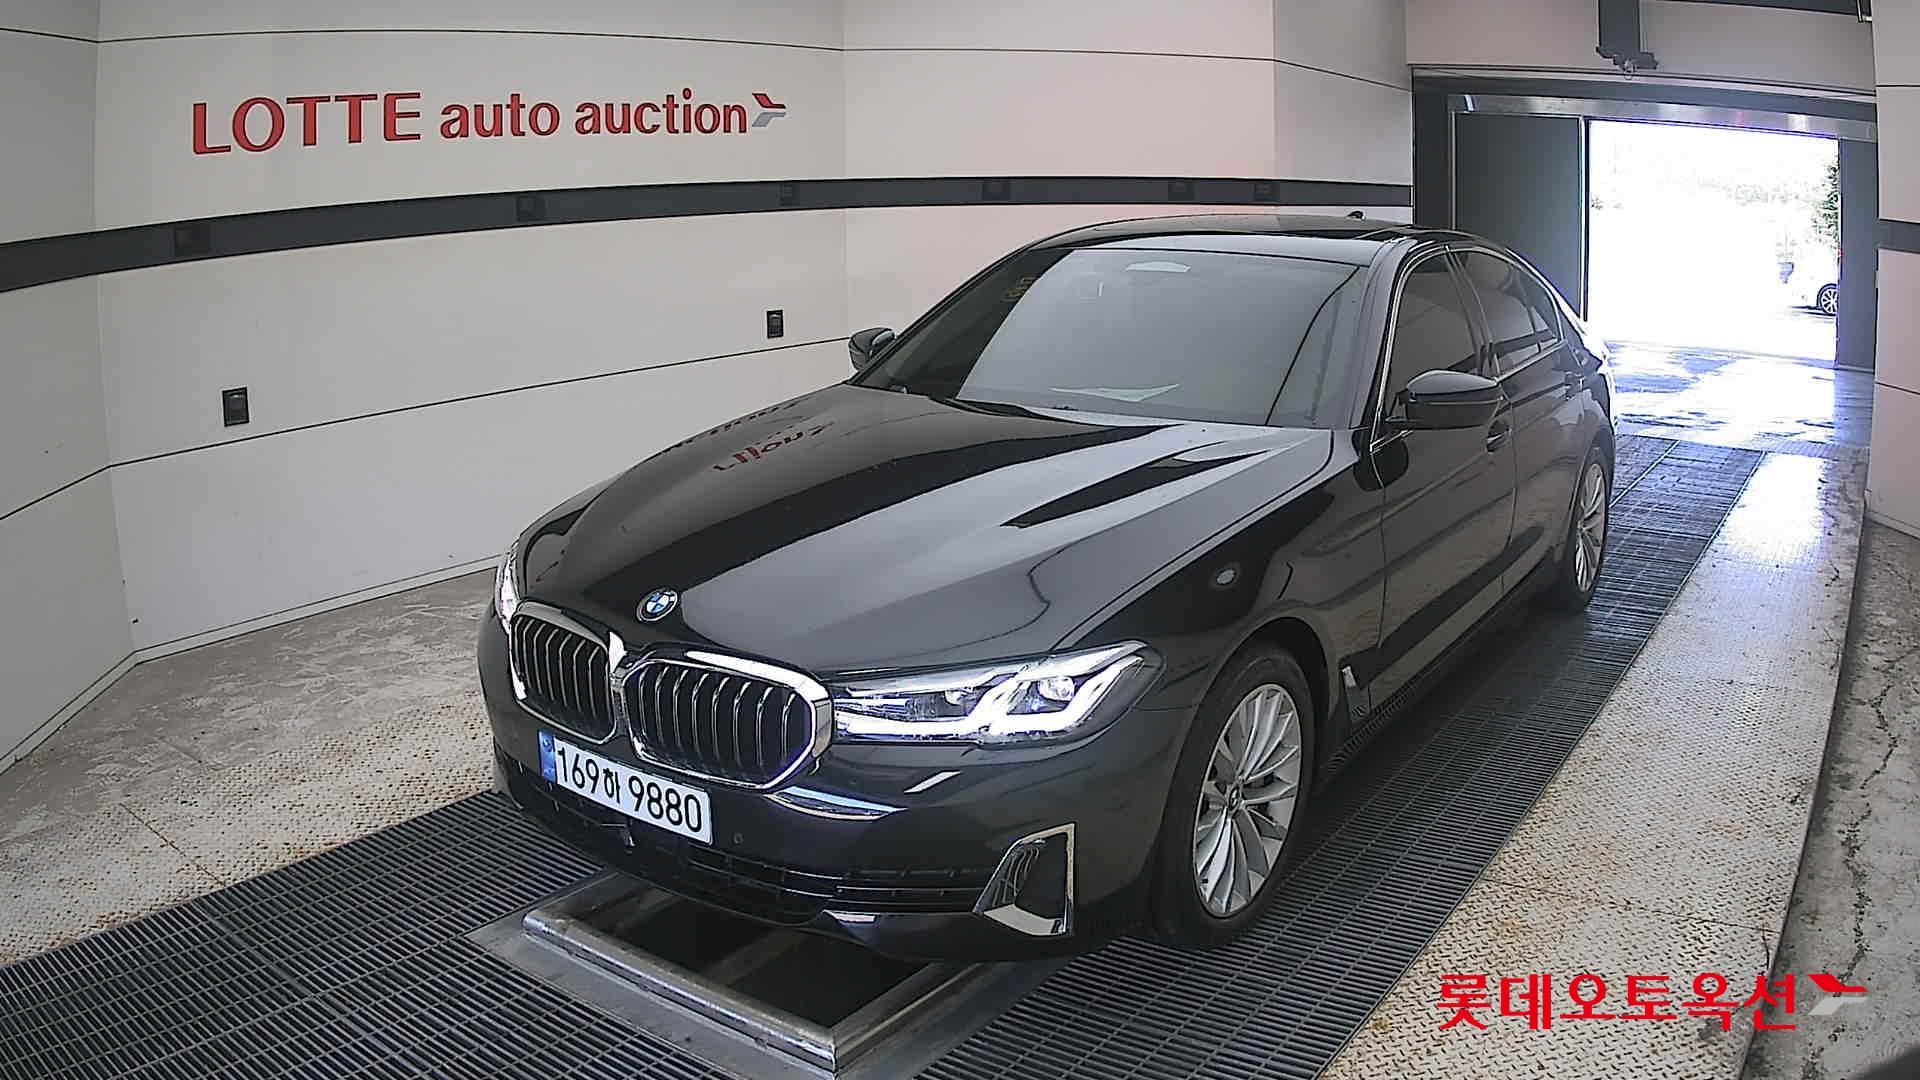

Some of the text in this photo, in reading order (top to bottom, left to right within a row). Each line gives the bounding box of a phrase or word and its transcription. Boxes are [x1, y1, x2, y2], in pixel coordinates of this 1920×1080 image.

[193, 88, 747, 155] LOTTE auto auction
[628, 775, 702, 832] 9880
